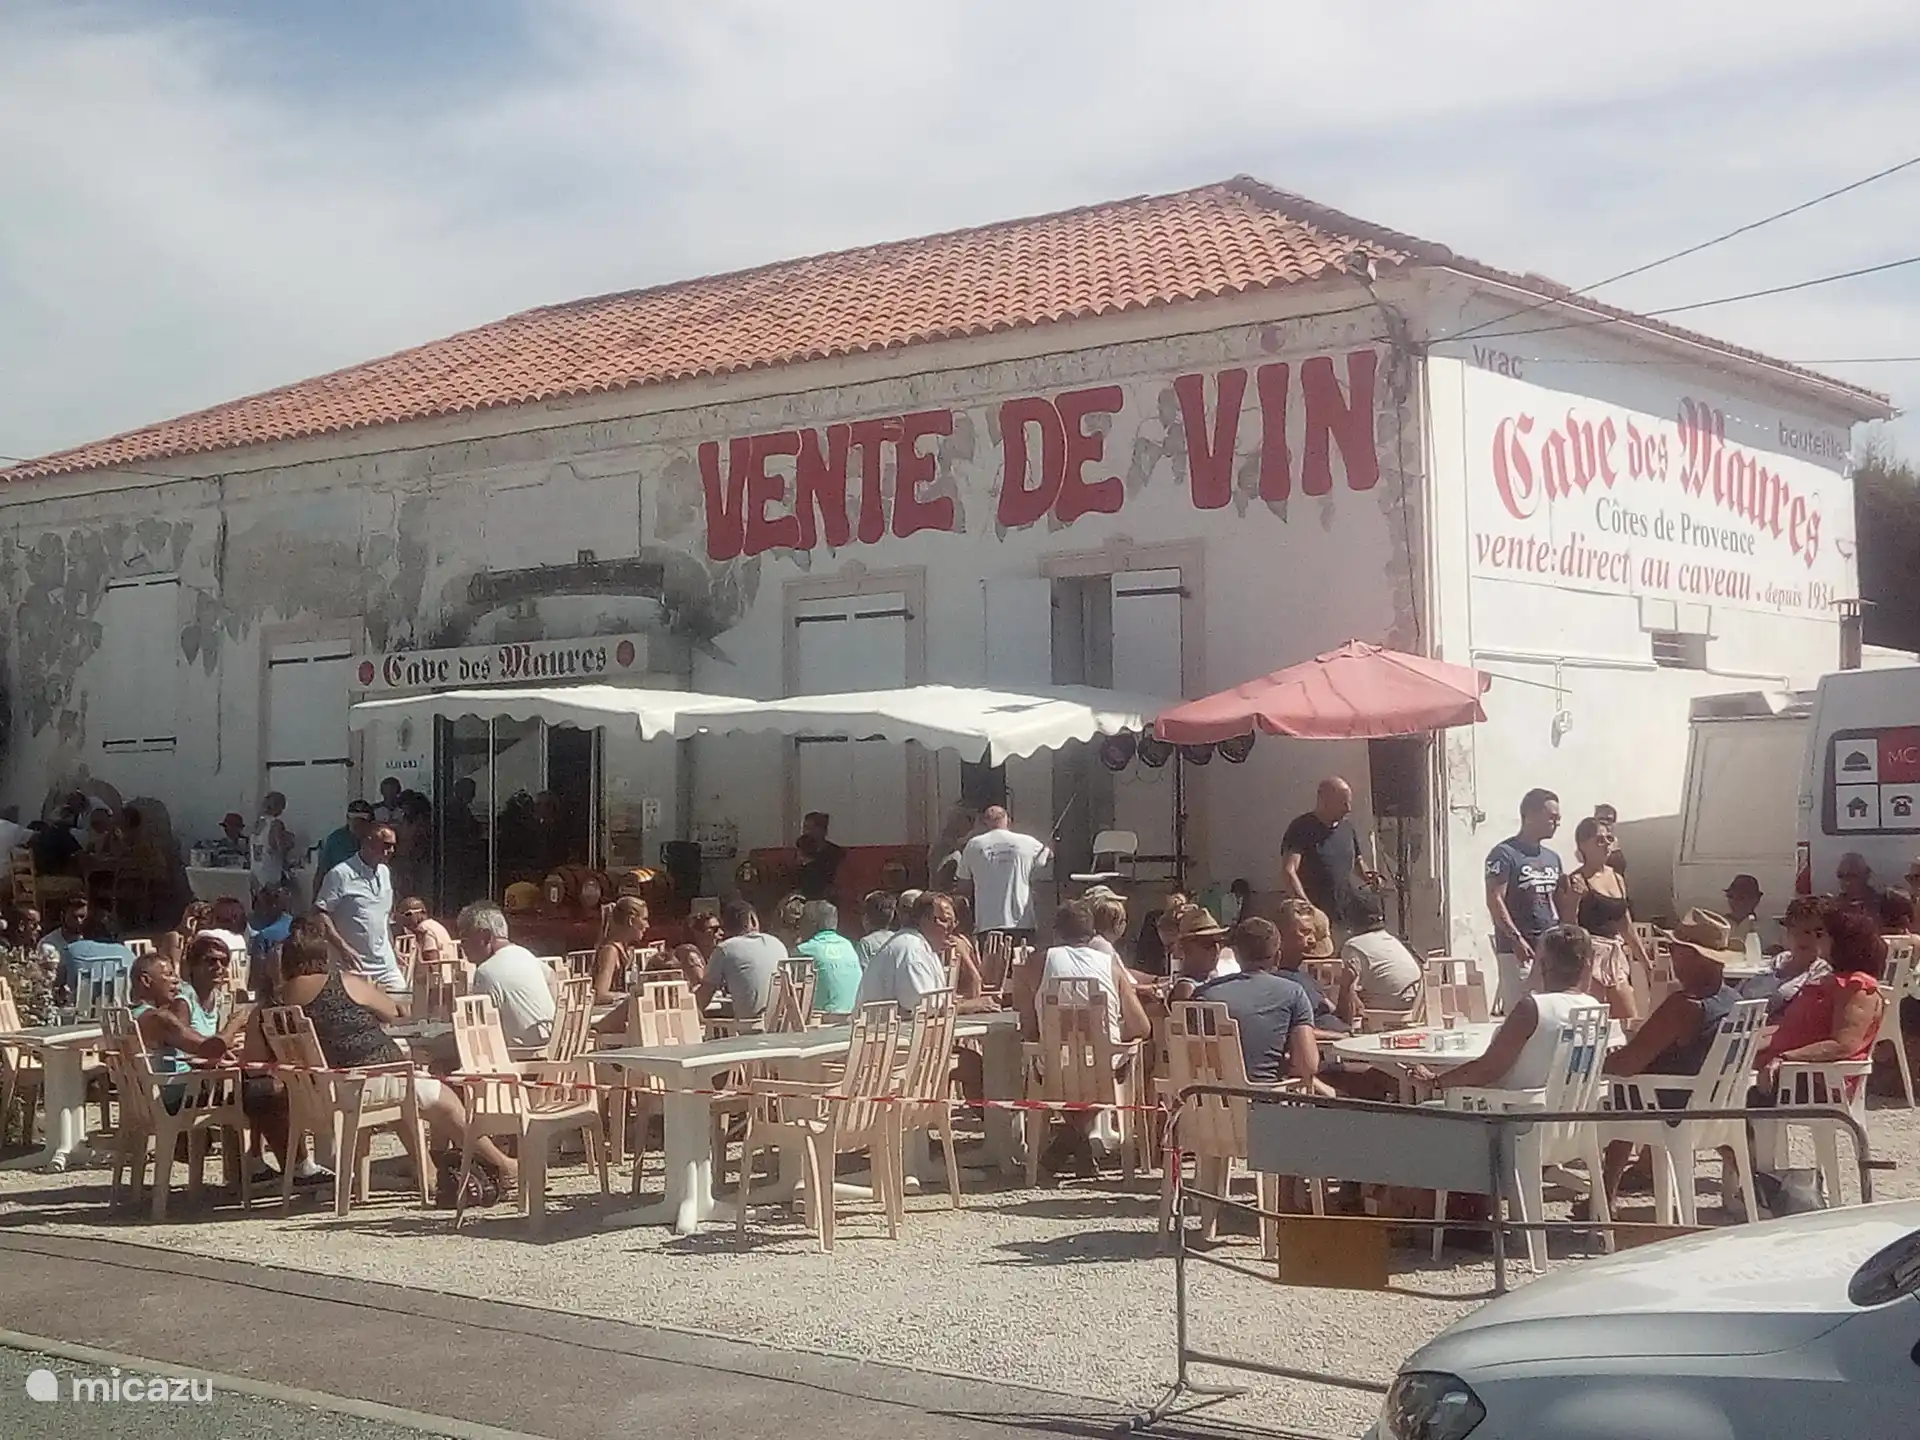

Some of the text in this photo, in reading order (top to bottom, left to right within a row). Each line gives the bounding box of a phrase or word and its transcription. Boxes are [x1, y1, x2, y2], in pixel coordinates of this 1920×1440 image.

[1473, 345, 1523, 379] vrac
[699, 349, 1379, 561] VENTE DE VIN
[1492, 396, 1822, 569] Cave des Maures
[1596, 497, 1755, 556] Côtes de Provence
[1640, 556, 1670, 590] au
[1764, 581, 1802, 612] depuis
[383, 643, 608, 687] Cave des Maures
